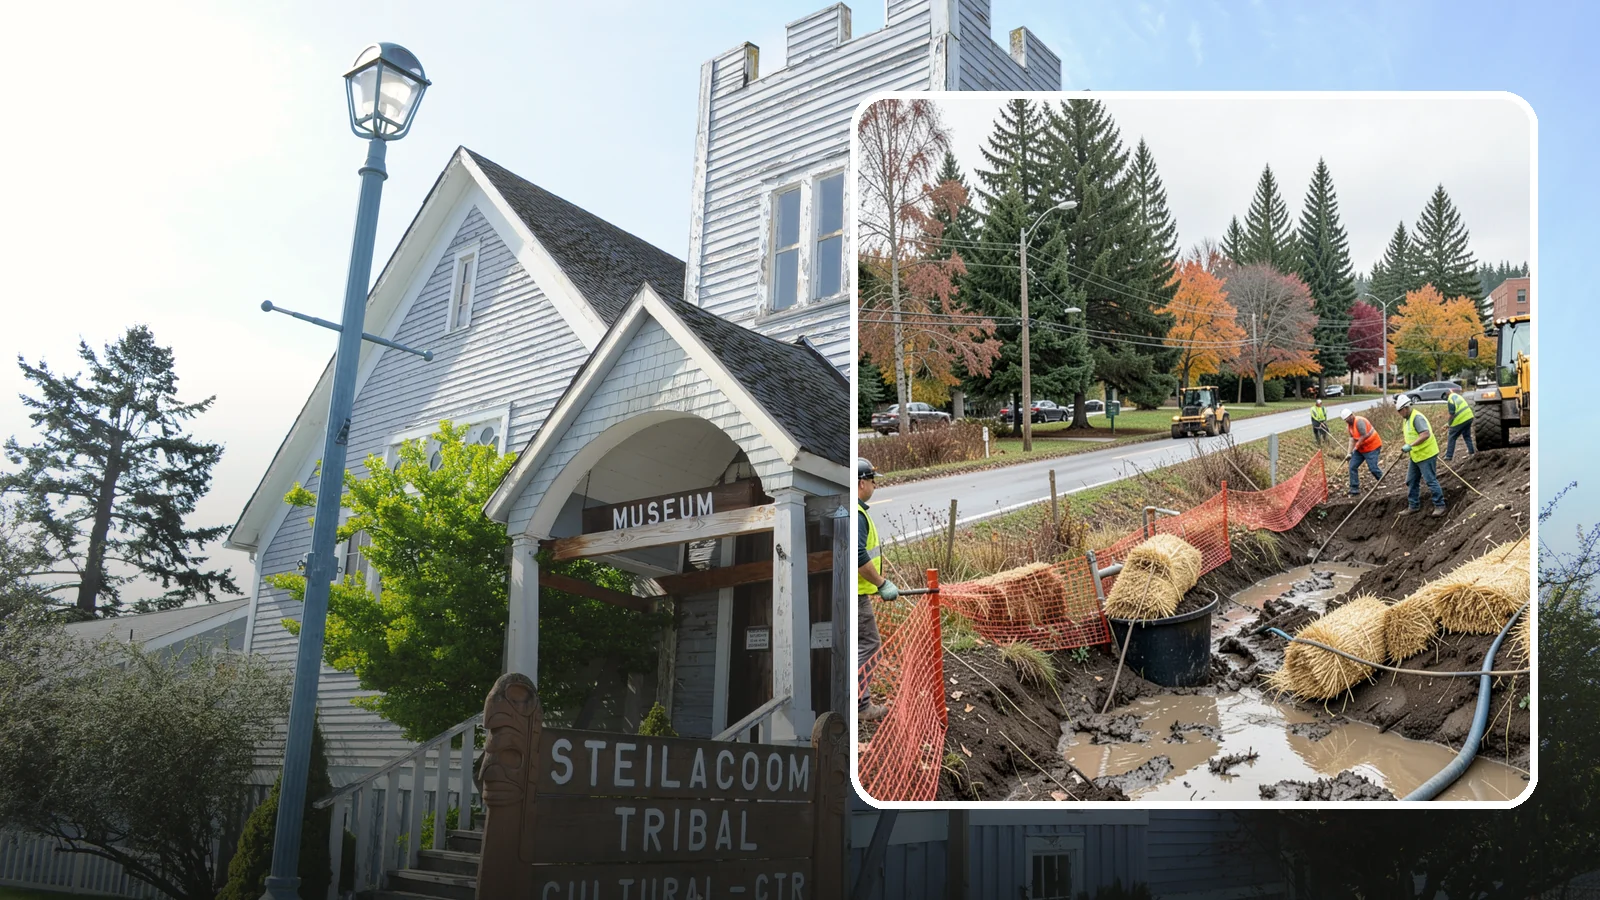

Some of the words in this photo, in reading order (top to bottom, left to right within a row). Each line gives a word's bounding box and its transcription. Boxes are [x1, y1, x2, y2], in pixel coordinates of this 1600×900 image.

[613, 491, 714, 530] MUSEUM
[551, 738, 810, 792] STEILACOOM
[614, 806, 758, 852] TRIBAL
